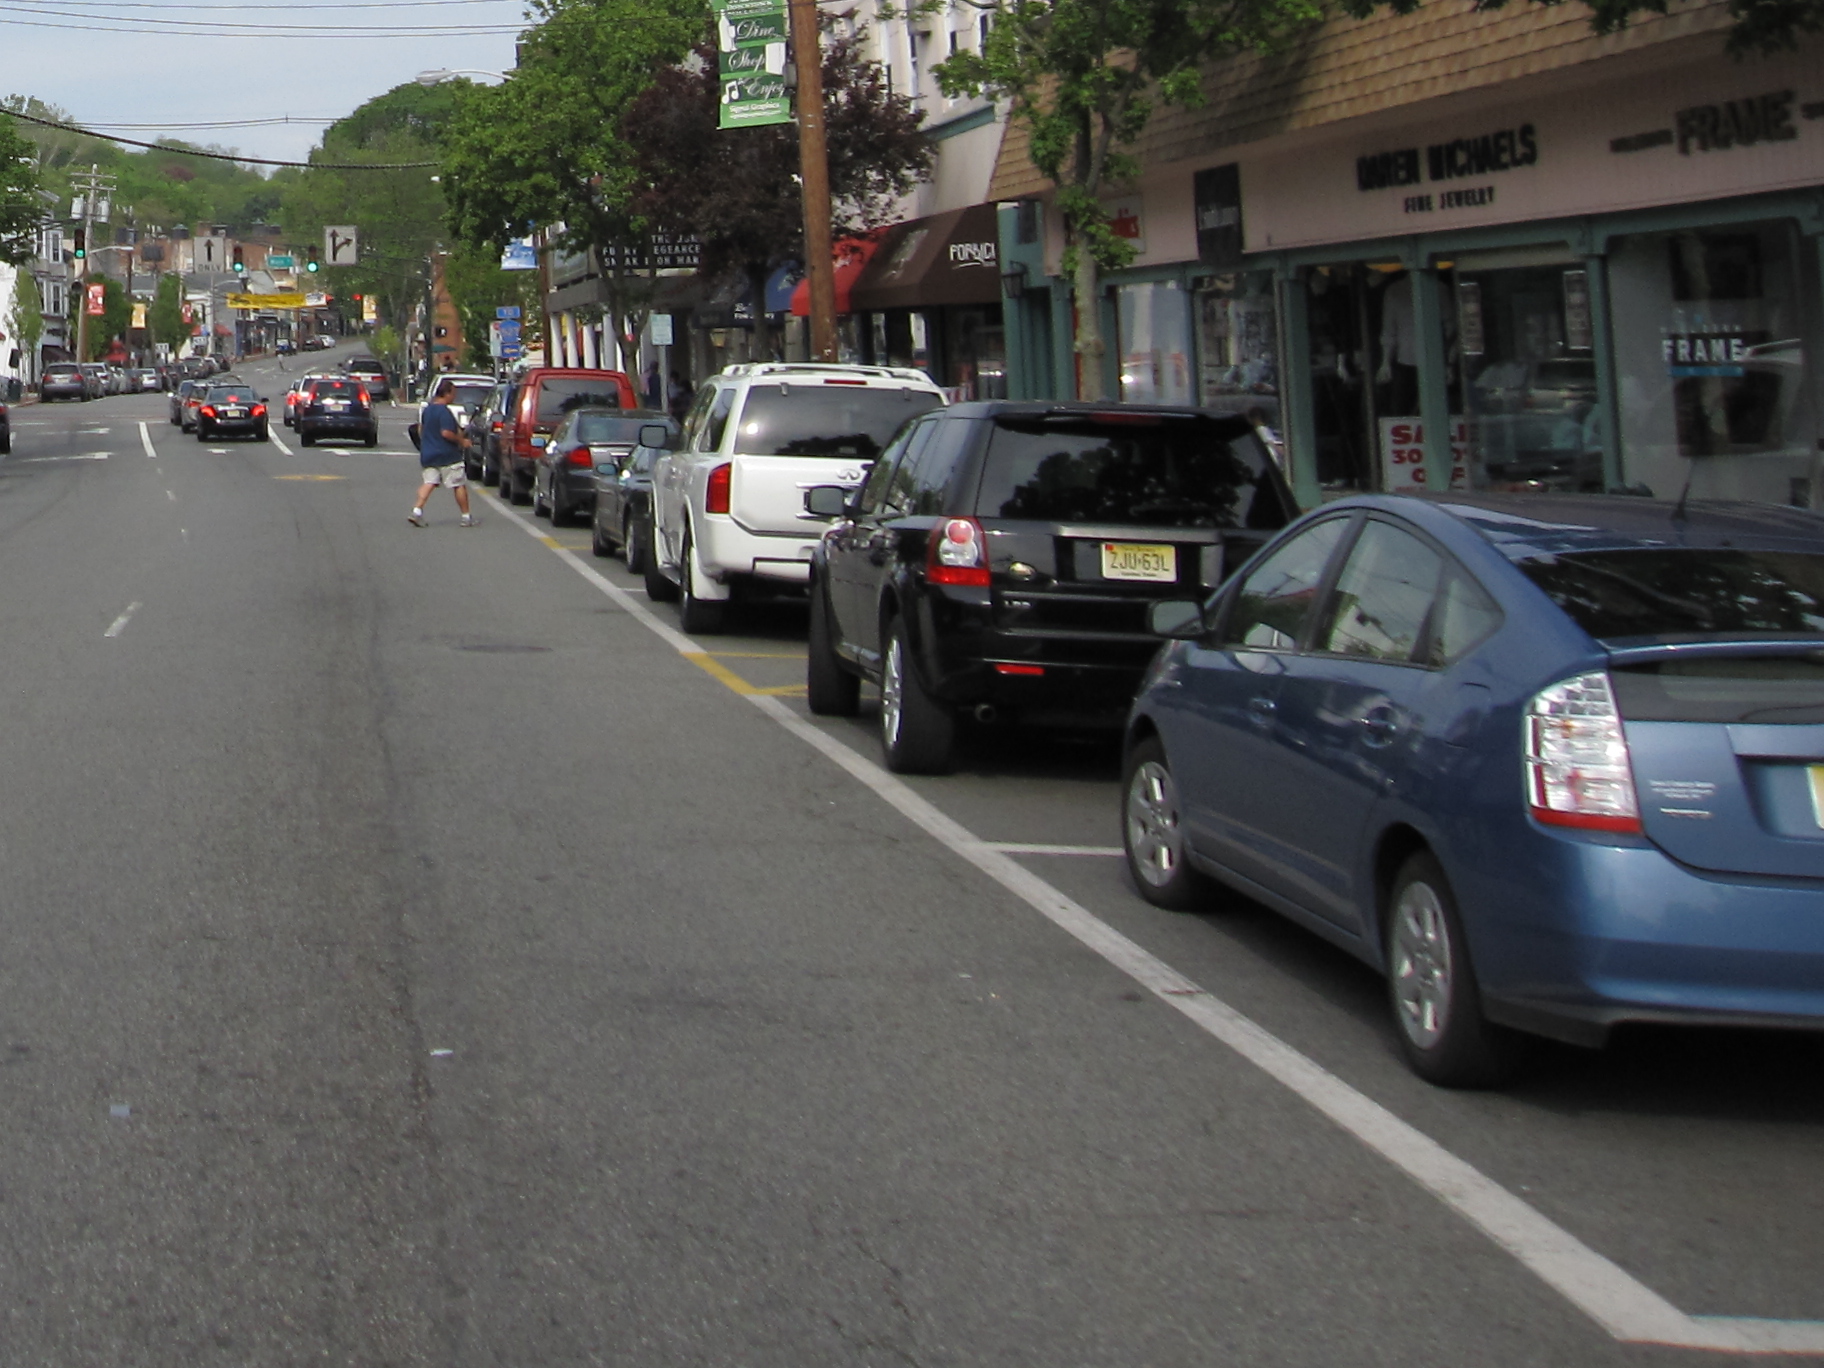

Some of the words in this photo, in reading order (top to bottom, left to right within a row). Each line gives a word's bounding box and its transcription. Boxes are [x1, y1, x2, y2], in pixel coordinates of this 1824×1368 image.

[736, 19, 776, 40] Dine
[728, 49, 766, 73] Shop
[745, 77, 786, 100] Enjoy
[1675, 89, 1799, 155] FRAME
[1428, 123, 1539, 182] MICHAELS
[1403, 194, 1433, 214] FINE
[1439, 185, 1496, 210] JEWELRY
[197, 263, 222, 272] ONLY
[1661, 338, 1744, 362] FRAME
